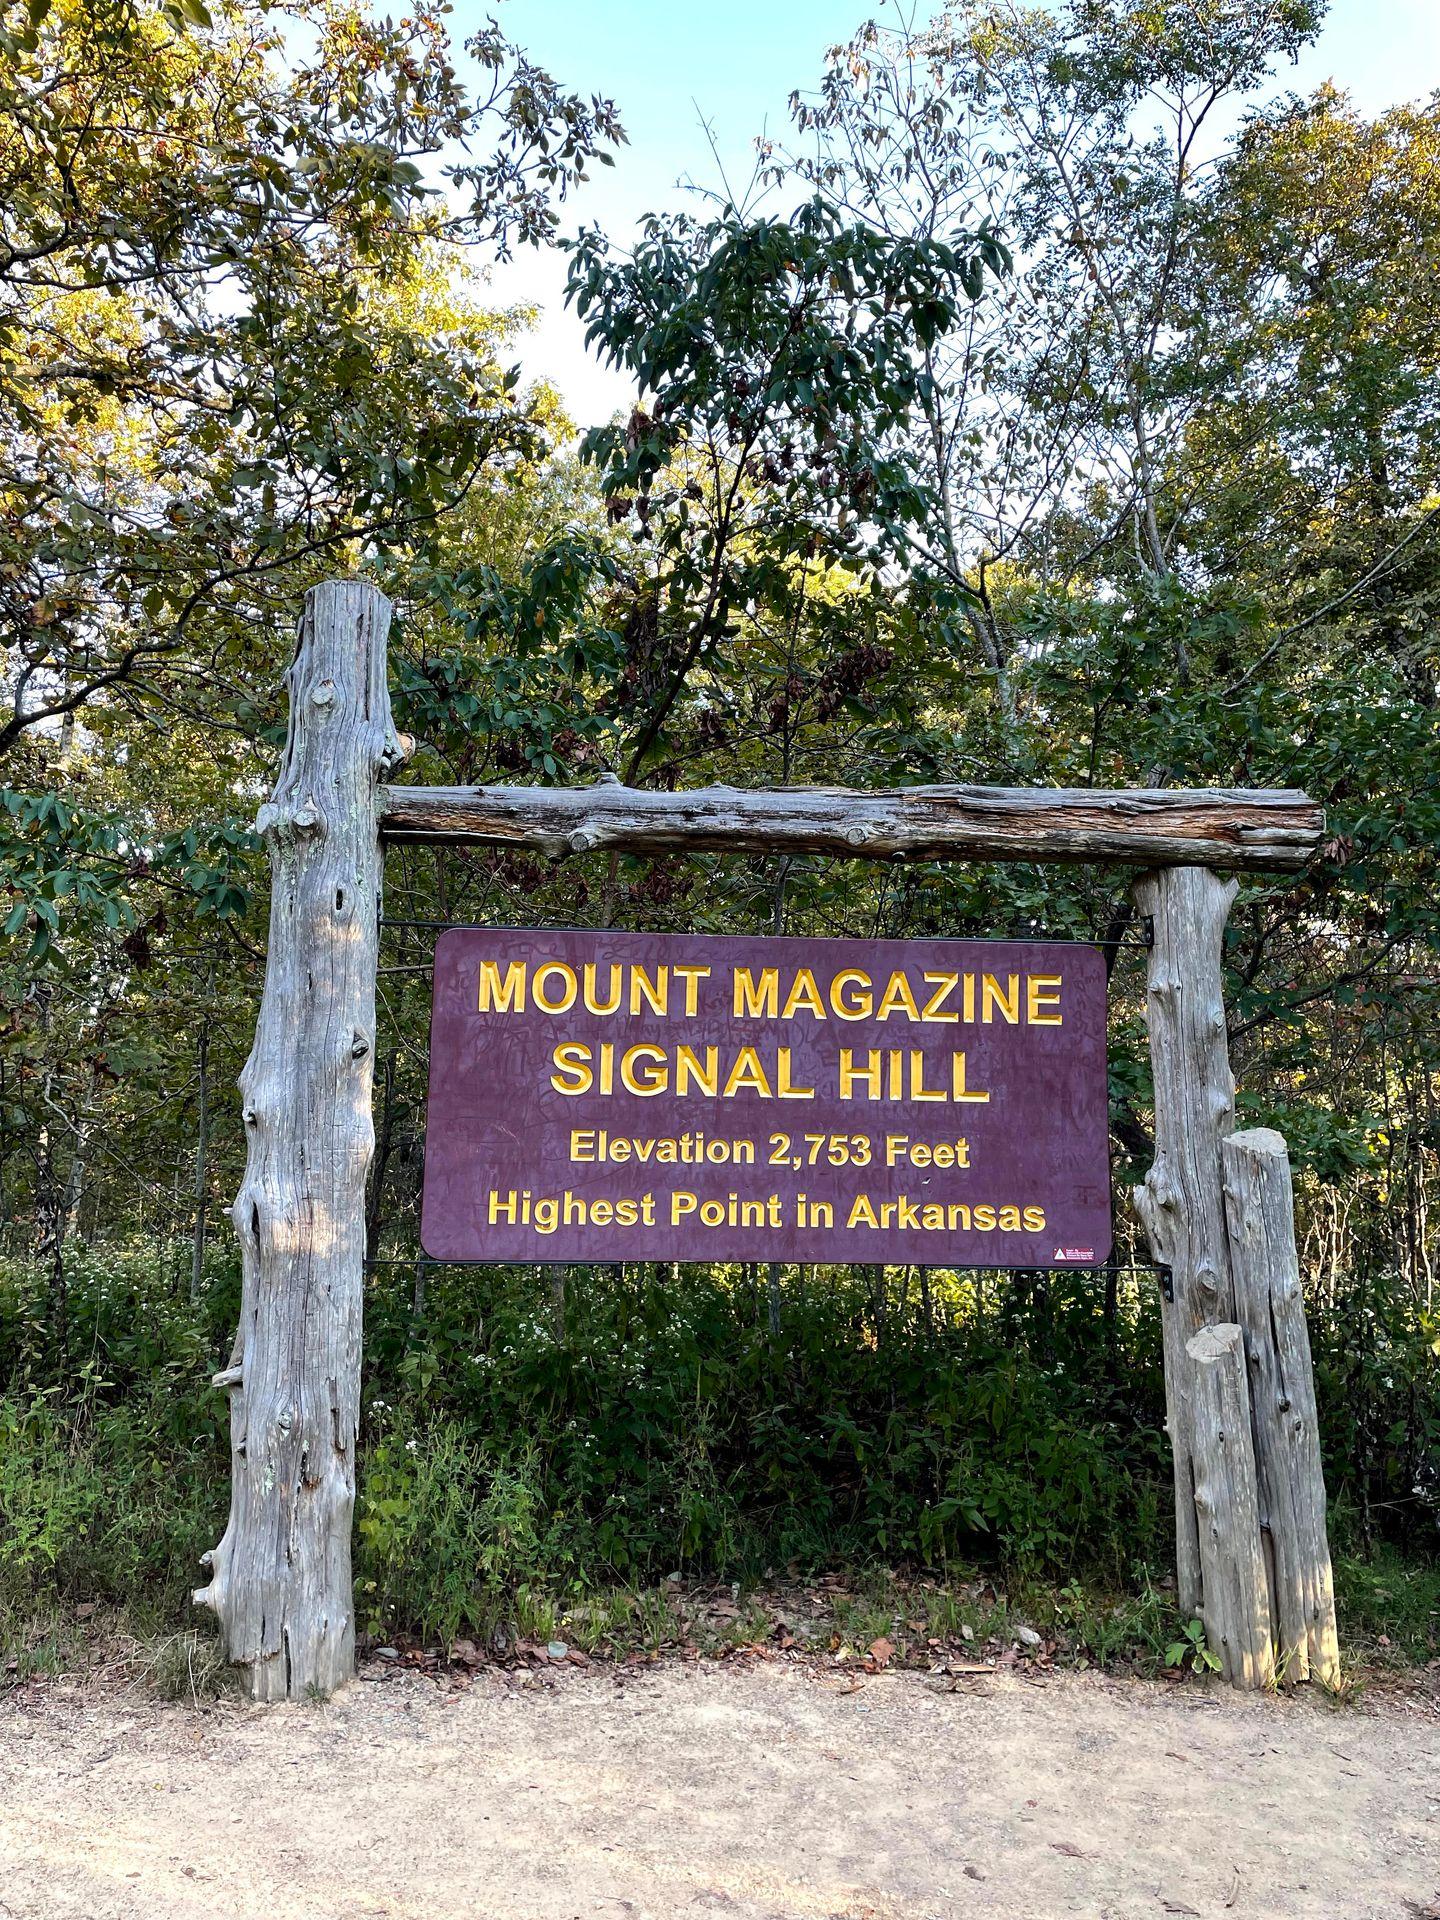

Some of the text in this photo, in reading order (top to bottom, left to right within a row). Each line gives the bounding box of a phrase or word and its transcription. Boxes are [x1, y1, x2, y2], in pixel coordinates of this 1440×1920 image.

[478, 959, 711, 1017] MOUNT
[733, 967, 1063, 1027] MAGAZINE
[550, 1042, 991, 1104] SIGNAL HILL
[570, 1130, 971, 1171] Elevation 2,753 Feet
[487, 1190, 1047, 1235] Highest Point in Arkansas
